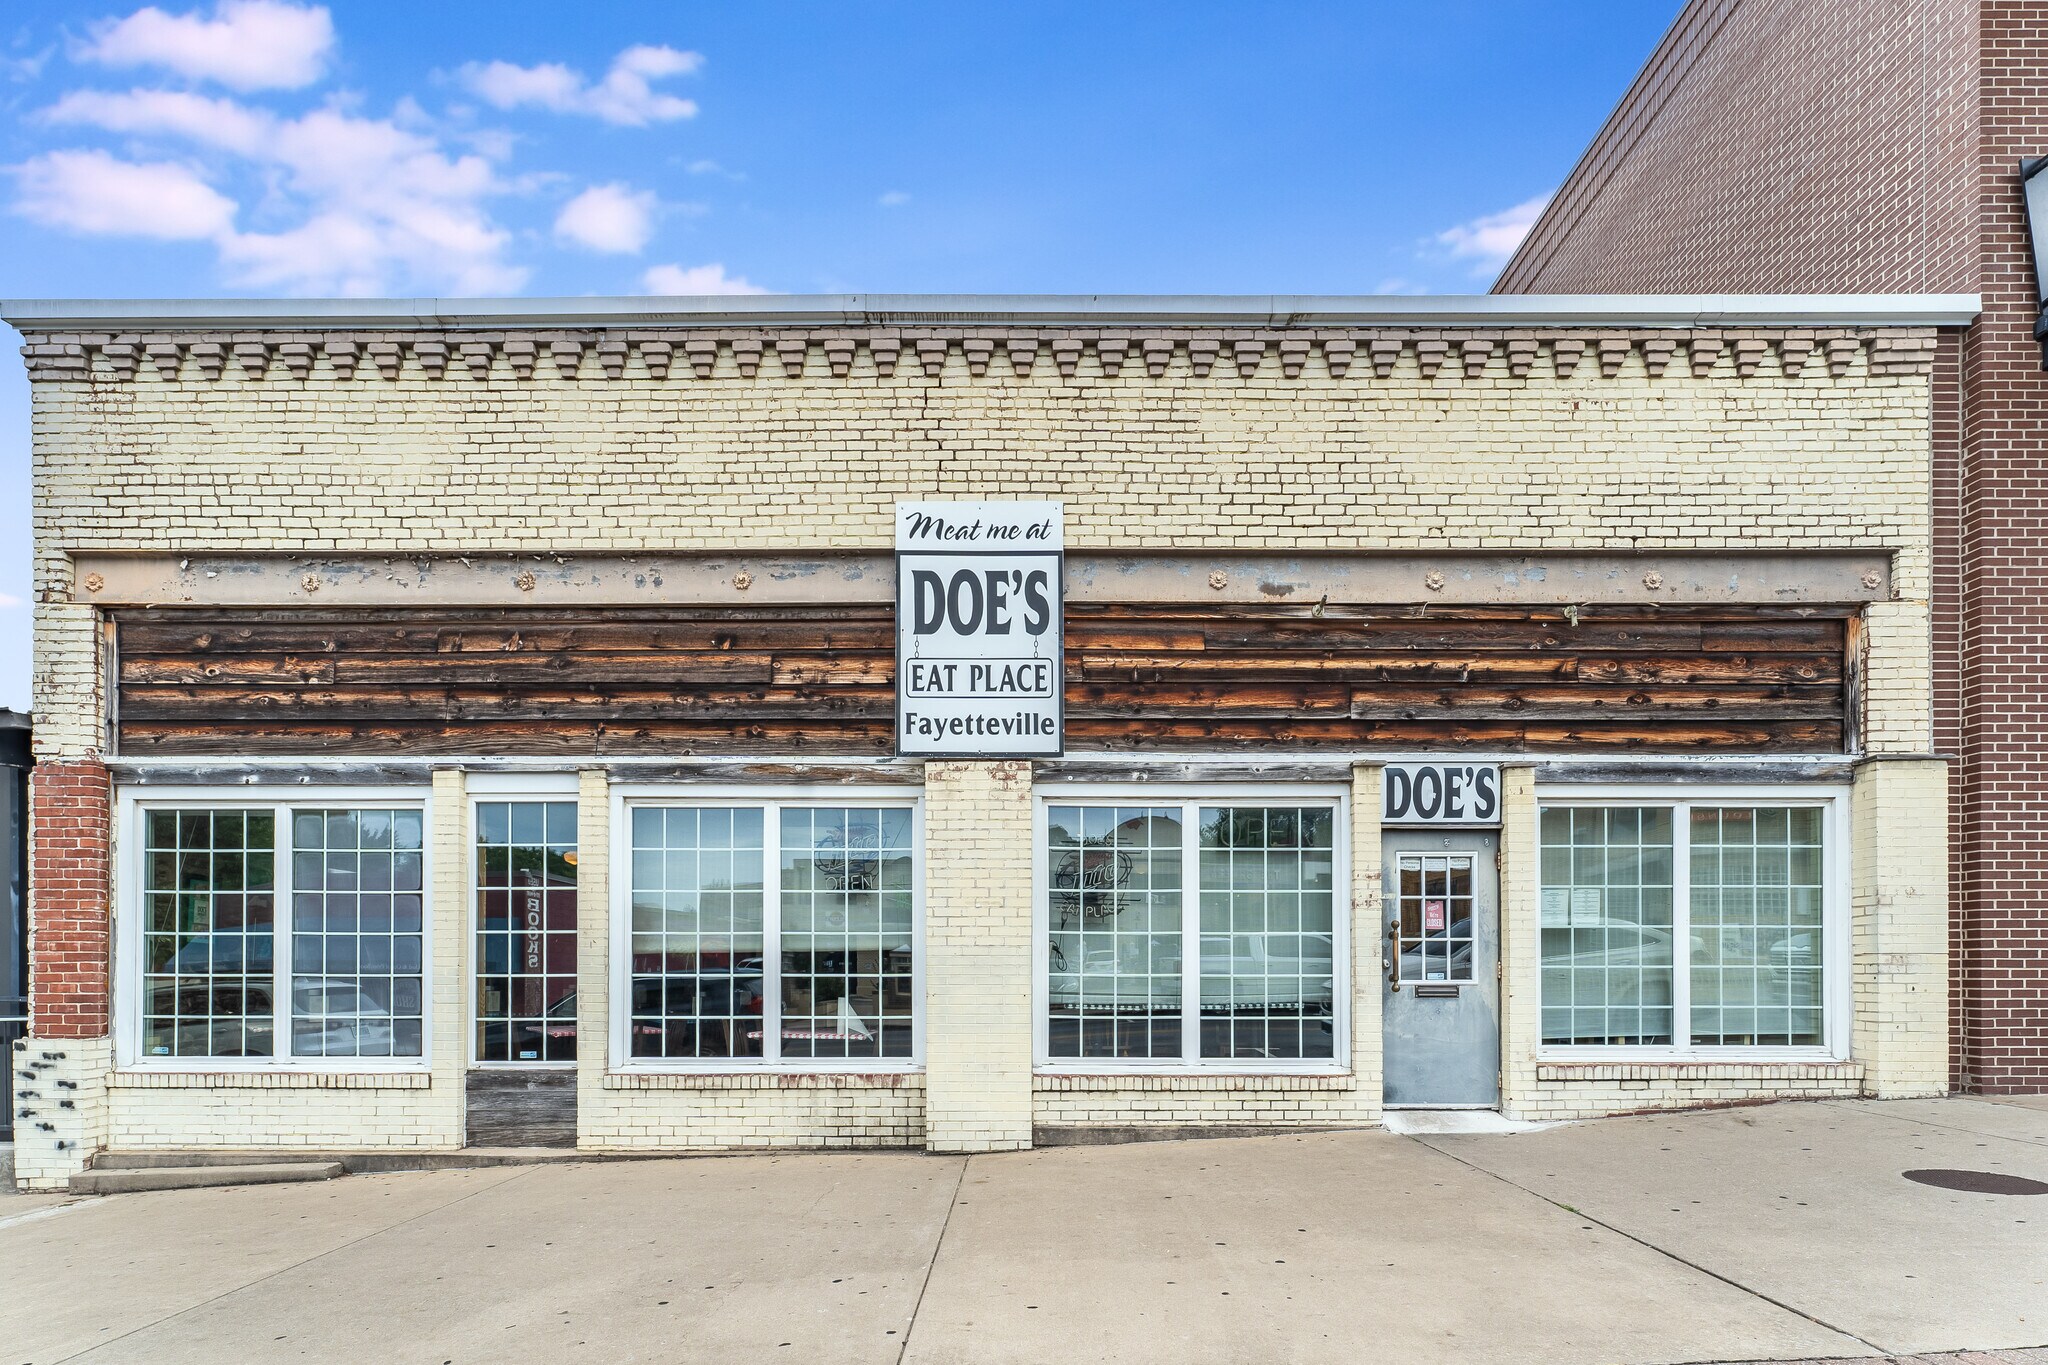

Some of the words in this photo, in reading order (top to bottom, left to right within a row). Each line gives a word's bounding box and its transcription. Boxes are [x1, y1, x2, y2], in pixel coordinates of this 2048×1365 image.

[905, 511, 983, 541] Meat
[986, 523, 1022, 541] me
[1025, 518, 1053, 541] at
[911, 569, 1050, 636] DOE'S
[911, 664, 957, 692] EAT
[970, 664, 1048, 692] PLACE
[905, 712, 1055, 741] Fayetteville
[1384, 766, 1496, 819] DOE'S
